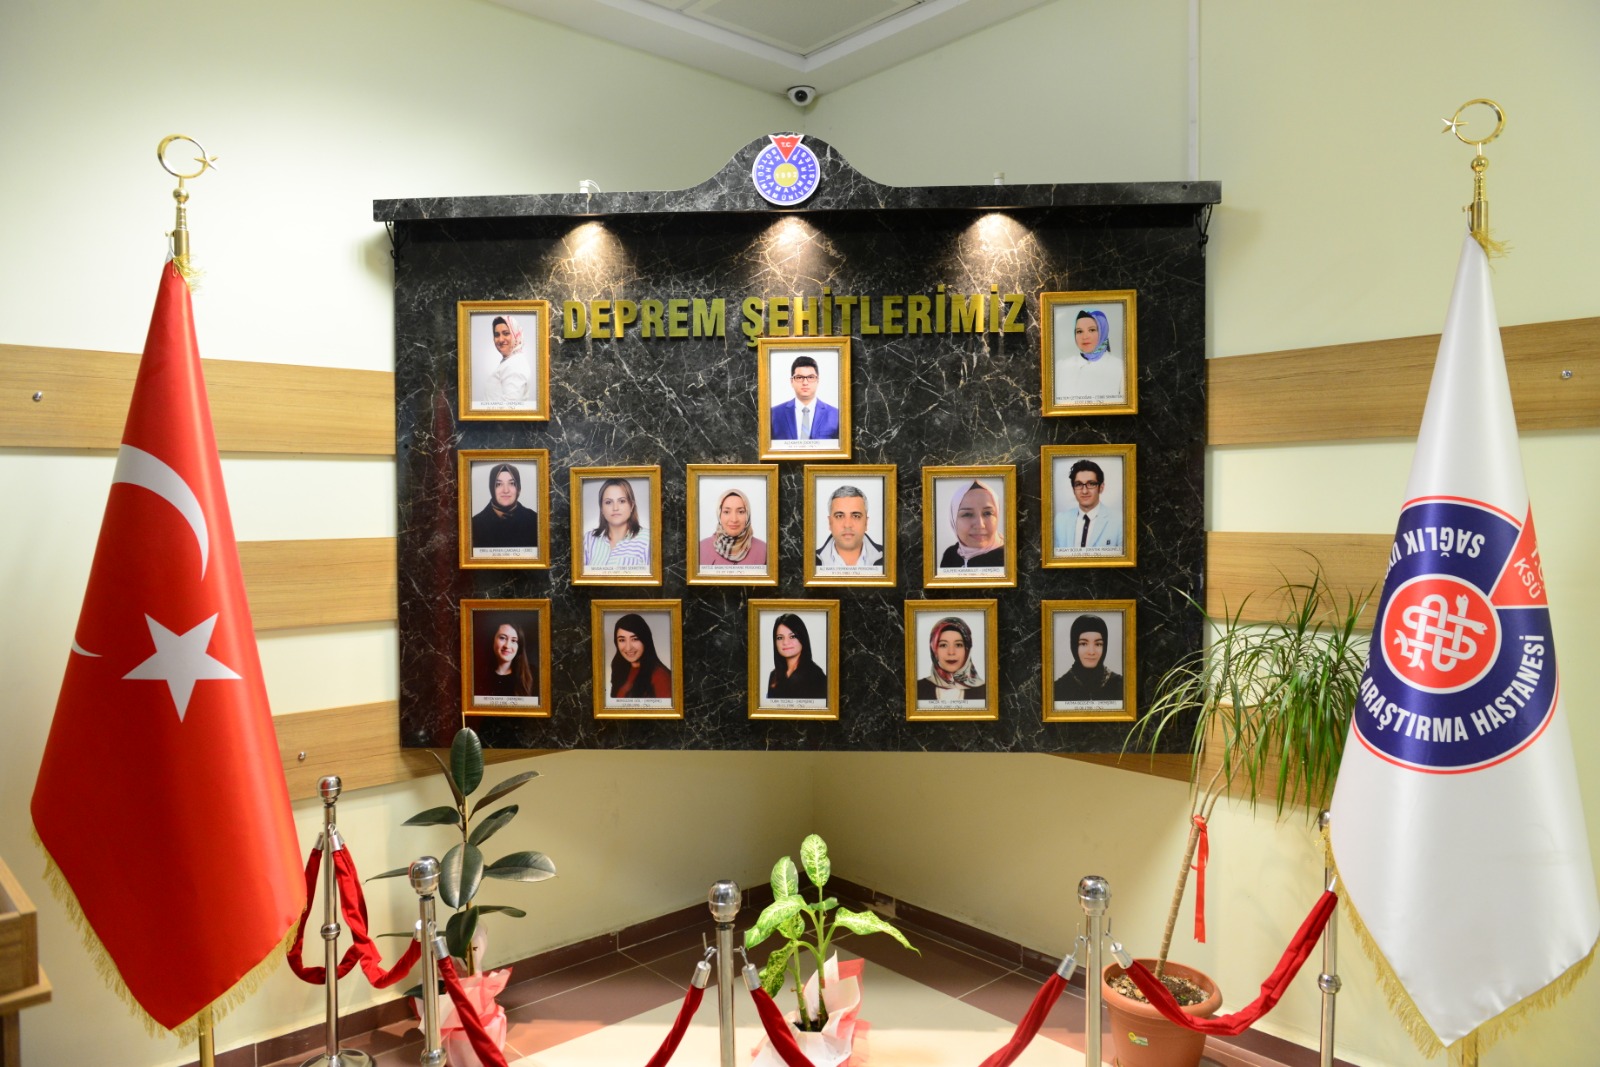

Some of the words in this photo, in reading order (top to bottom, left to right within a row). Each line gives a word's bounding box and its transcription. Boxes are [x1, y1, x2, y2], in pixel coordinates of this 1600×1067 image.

[563, 298, 725, 339] DEPREM
[741, 284, 1025, 348] ŞEHİTLERİMİZ
[1402, 526, 1486, 558] SAĞLIK
[1513, 557, 1541, 599] KSÜ
[1360, 676, 1469, 743] ARAŞTIRMA
[1470, 634, 1545, 737] HASTANESİ
